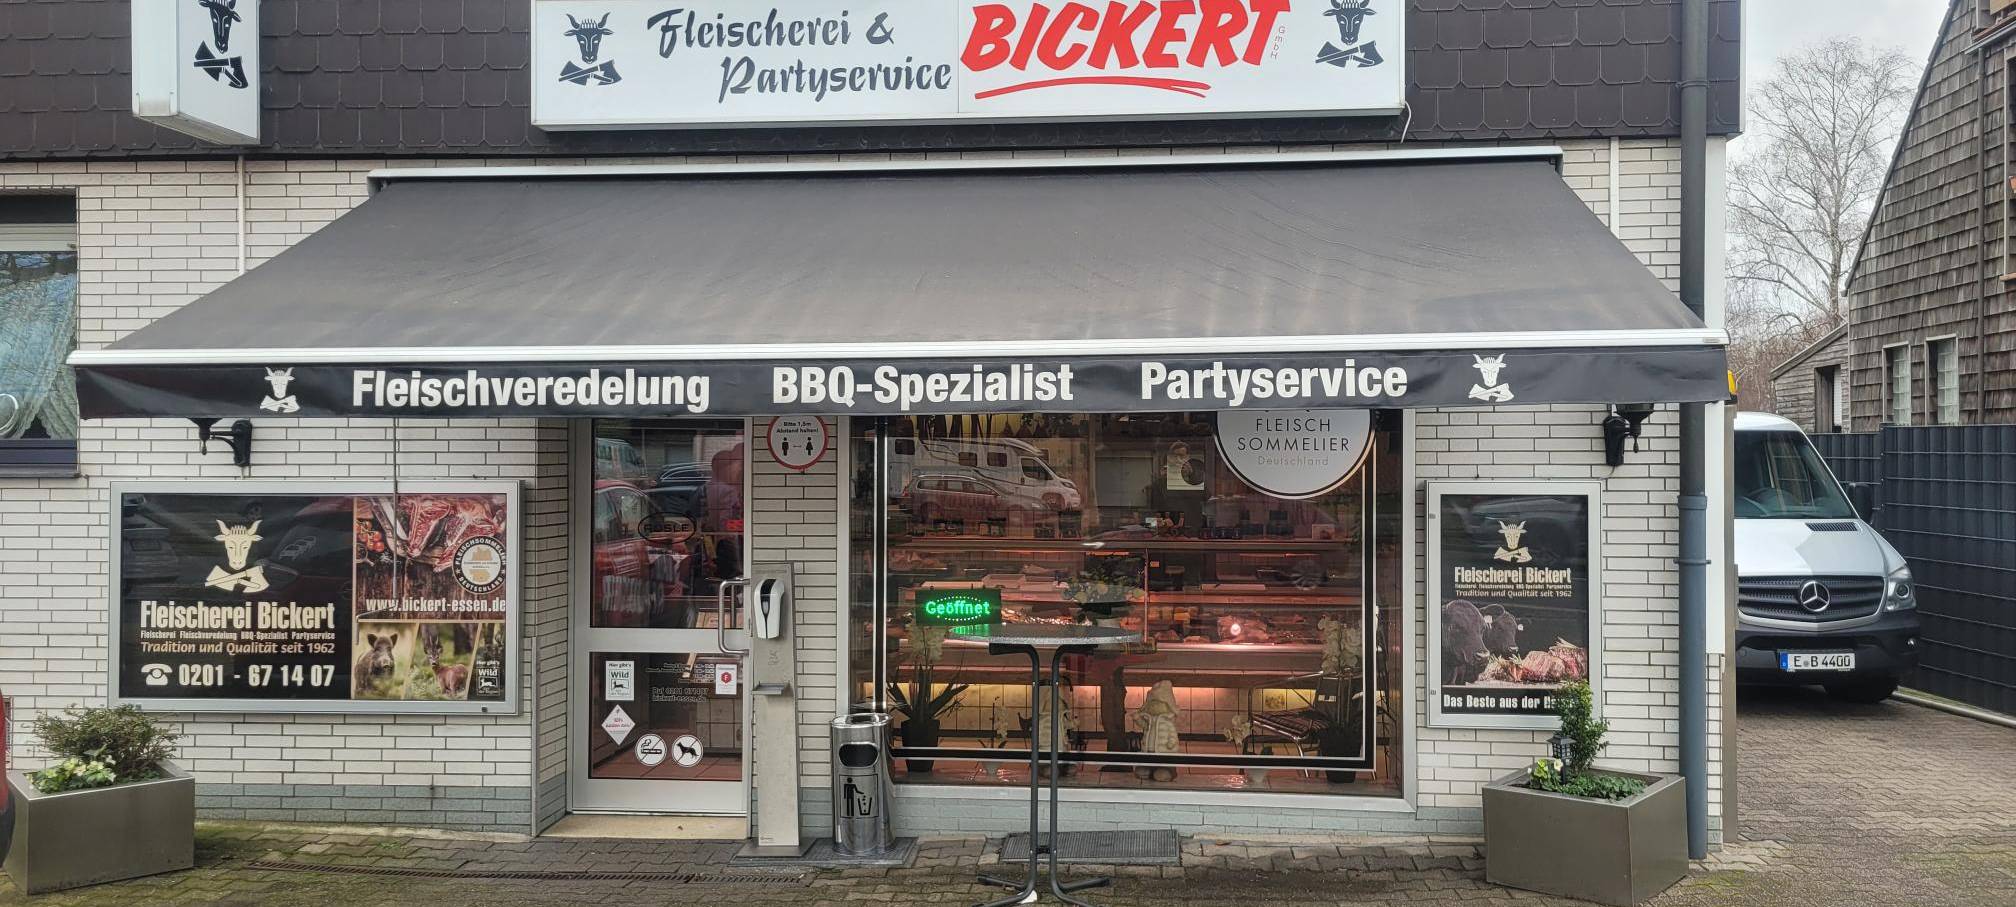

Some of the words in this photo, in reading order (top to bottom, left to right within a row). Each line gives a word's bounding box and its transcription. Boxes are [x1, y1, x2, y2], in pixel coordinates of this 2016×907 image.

[647, 8, 851, 58] Fleischerei
[866, 11, 895, 45] &
[960, 0, 1291, 72] BICKERT
[718, 56, 952, 104] Partyservice
[352, 369, 710, 413] Fleischveredelung
[773, 361, 1074, 412] BBQ-Spezialist
[1141, 358, 1408, 406] Partyservice
[1256, 418, 1331, 432] FLEISCH
[1238, 437, 1350, 451] SOMMELIER
[1257, 455, 1329, 466] Deutschland
[1454, 567, 1522, 583] Fleischerei
[1526, 567, 1572, 583] Bickert
[1508, 590, 1538, 598] Qualität
[366, 596, 506, 612] www.bickert-essen.de
[925, 600, 991, 615] Geöffnet
[140, 600, 252, 629] Fleischerei
[257, 601, 336, 630] Bickert
[140, 641, 196, 653] Tradition
[199, 642, 223, 653] und
[226, 641, 278, 655] Qualität
[280, 641, 303, 653] seit
[306, 642, 336, 653] 1962
[1793, 655, 1802, 668] E
[1810, 655, 1819, 667] B
[1821, 655, 1851, 667] 4400
[178, 664, 225, 686] 0201
[248, 664, 273, 687] 67
[280, 664, 304, 687] 14
[310, 664, 336, 687] 07
[478, 668, 498, 677] Wild
[1443, 694, 1463, 708] Das
[1466, 694, 1496, 708] Beste
[1499, 696, 1518, 708] aus
[1521, 695, 1540, 709] der
